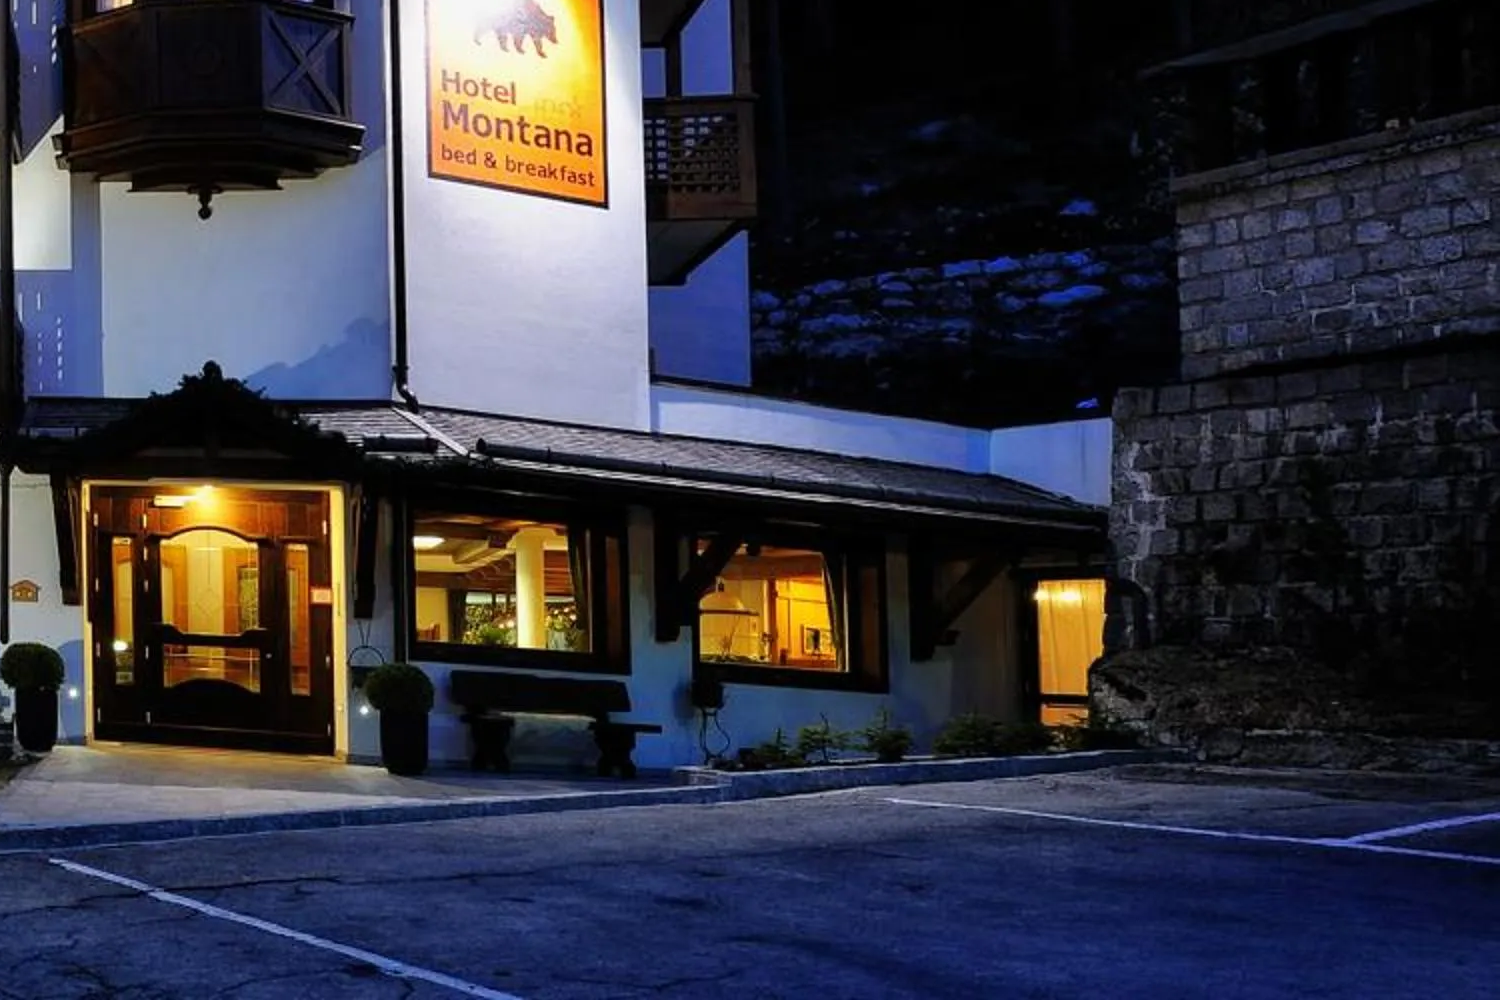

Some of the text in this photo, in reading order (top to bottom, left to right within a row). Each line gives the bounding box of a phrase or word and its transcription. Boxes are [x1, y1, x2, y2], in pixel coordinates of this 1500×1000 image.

[441, 69, 517, 105] Hotel
[442, 100, 593, 157] Montana
[441, 143, 595, 187] bed & breakfast
